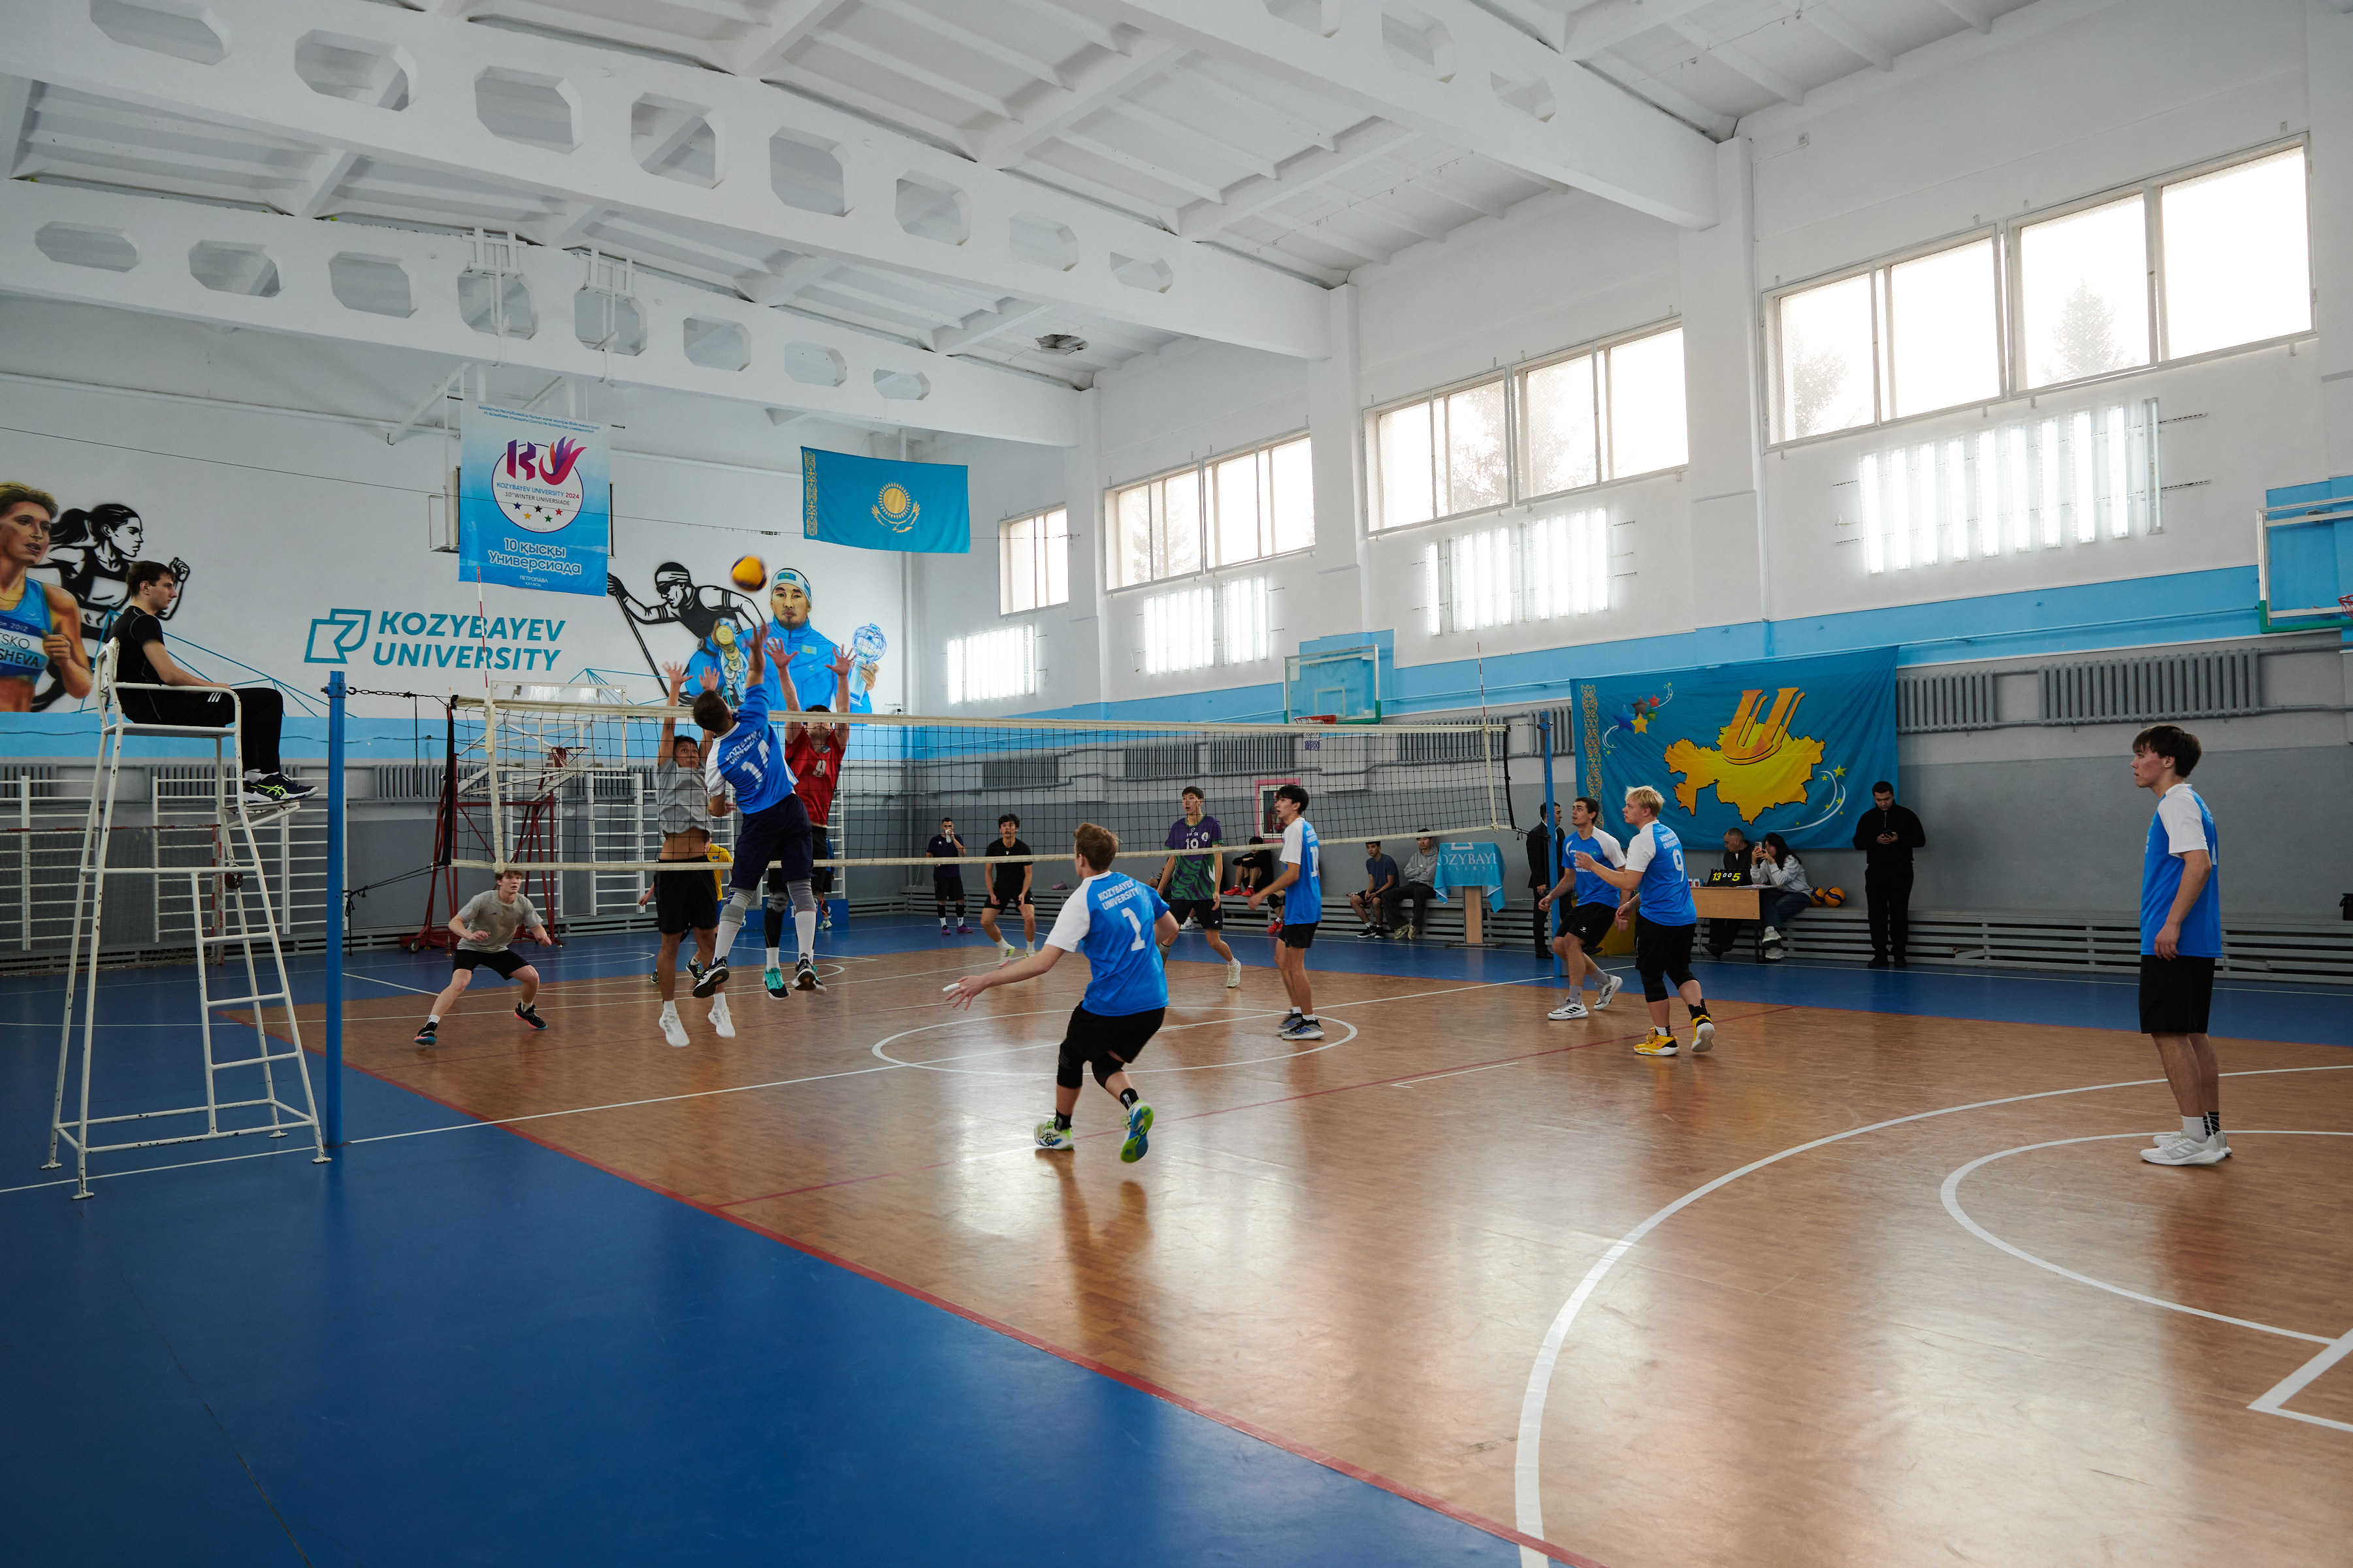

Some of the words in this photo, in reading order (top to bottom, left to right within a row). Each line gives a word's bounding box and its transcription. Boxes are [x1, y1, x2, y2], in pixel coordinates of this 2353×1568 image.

[496, 482, 530, 492] KOZYBAYEV
[532, 487, 564, 497] UNIVERSITY
[536, 496, 570, 506] UNIVERSIADE
[504, 537, 518, 552] 10
[488, 550, 581, 575] Универсиада
[519, 575, 548, 583] ПЕТРОПАВЛ
[10, 622, 28, 632] 2012
[378, 610, 566, 642] KOZYBAYEV
[373, 641, 561, 671] UNIVERSITY
[813, 760, 826, 777] 9
[1672, 848, 1684, 882] 9
[1712, 872, 1722, 881] 13
[1732, 872, 1741, 882] 5
[1097, 879, 1134, 901] KOZYBAYEV
[1101, 887, 1139, 910] UNIVERSITY
[1121, 907, 1146, 952] 1
